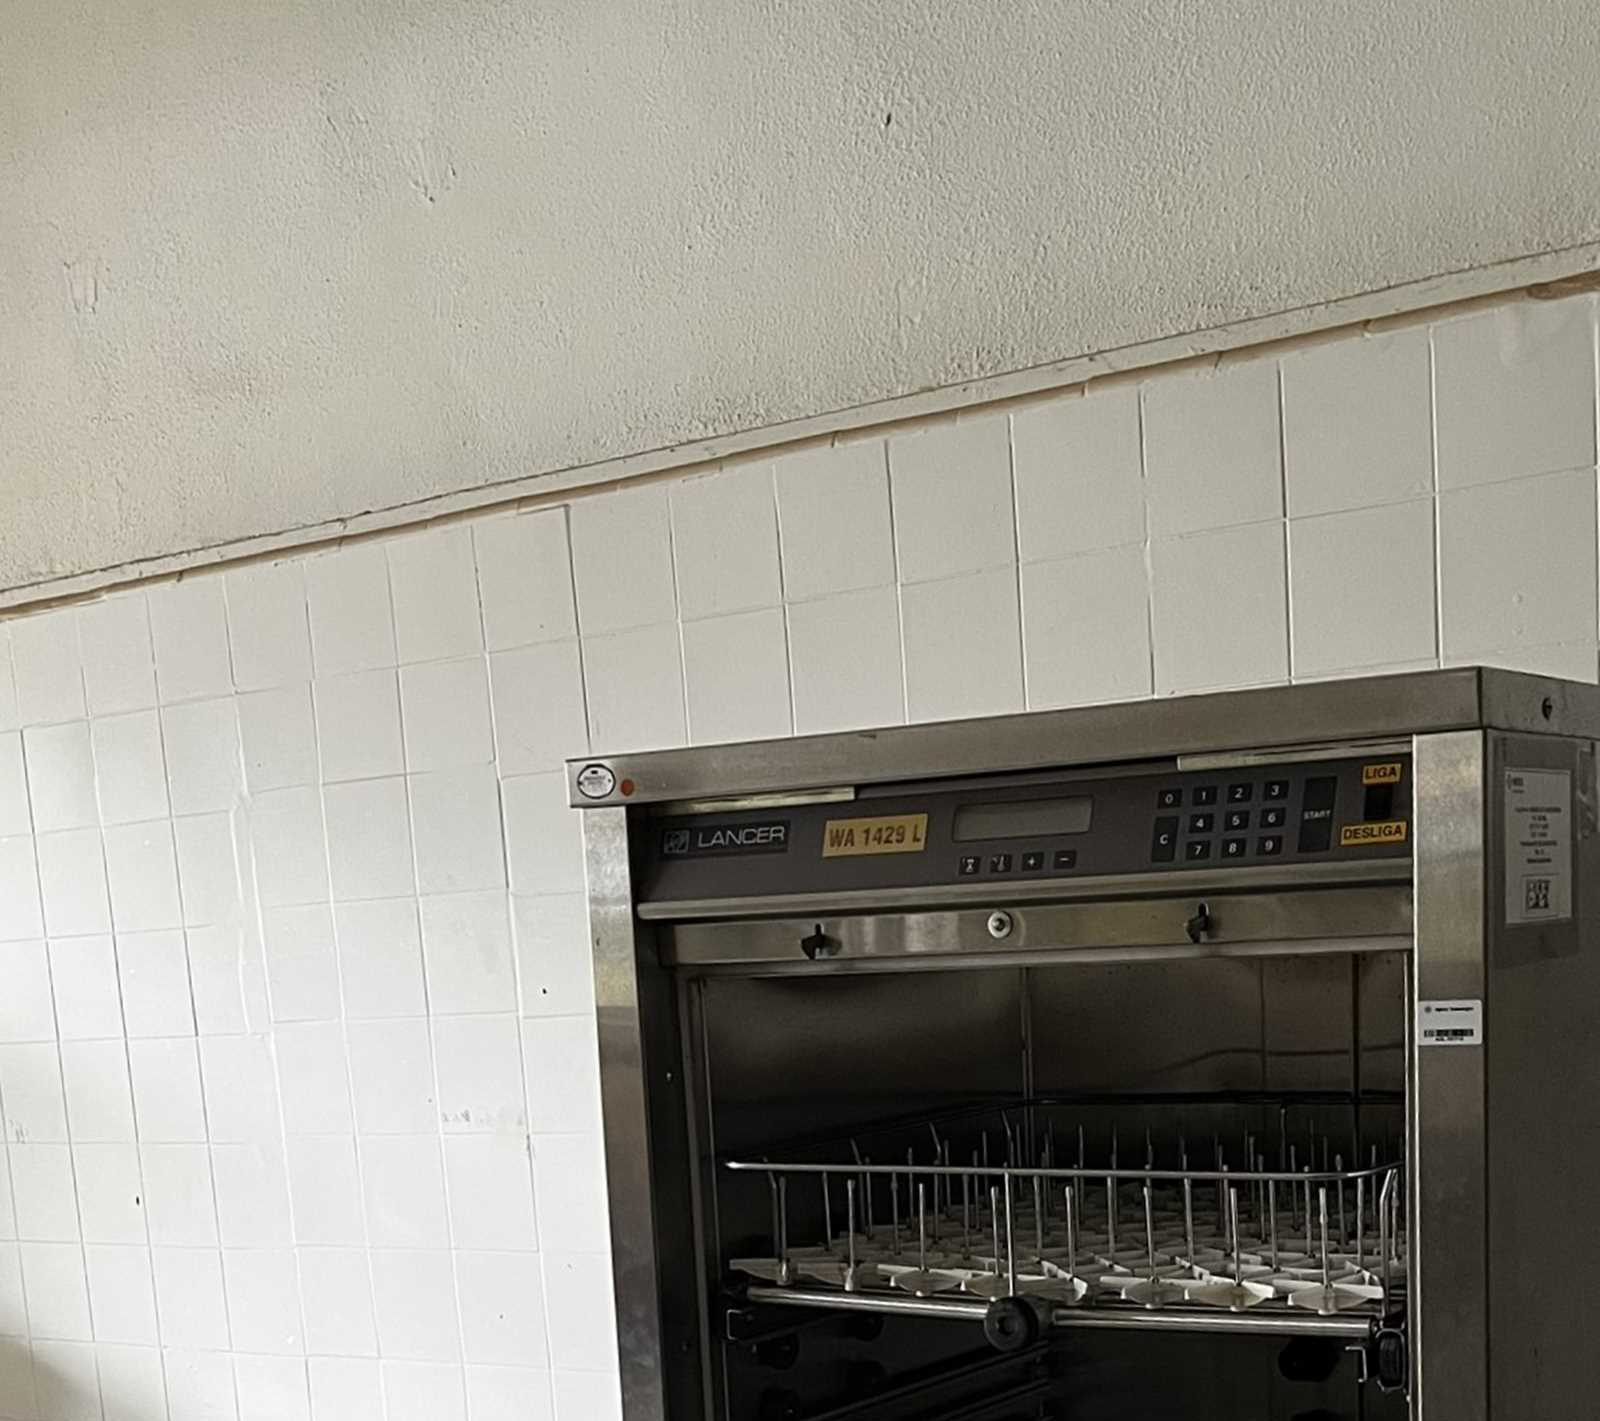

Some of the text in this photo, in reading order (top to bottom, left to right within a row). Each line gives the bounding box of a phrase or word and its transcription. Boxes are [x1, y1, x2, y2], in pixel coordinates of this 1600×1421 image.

[1365, 766, 1397, 779] LIGA
[1201, 791, 1207, 801] 1
[1234, 787, 1243, 799] 2
[1271, 785, 1280, 796] 3
[1196, 812, 1276, 828] 4 5 6
[1303, 810, 1331, 820] START
[697, 825, 785, 848] LANCER
[828, 825, 922, 848] WA 1429 L
[1160, 834, 1169, 845] C
[1343, 825, 1402, 840] DESLIGA
[1195, 840, 1274, 855] 7 8 9
